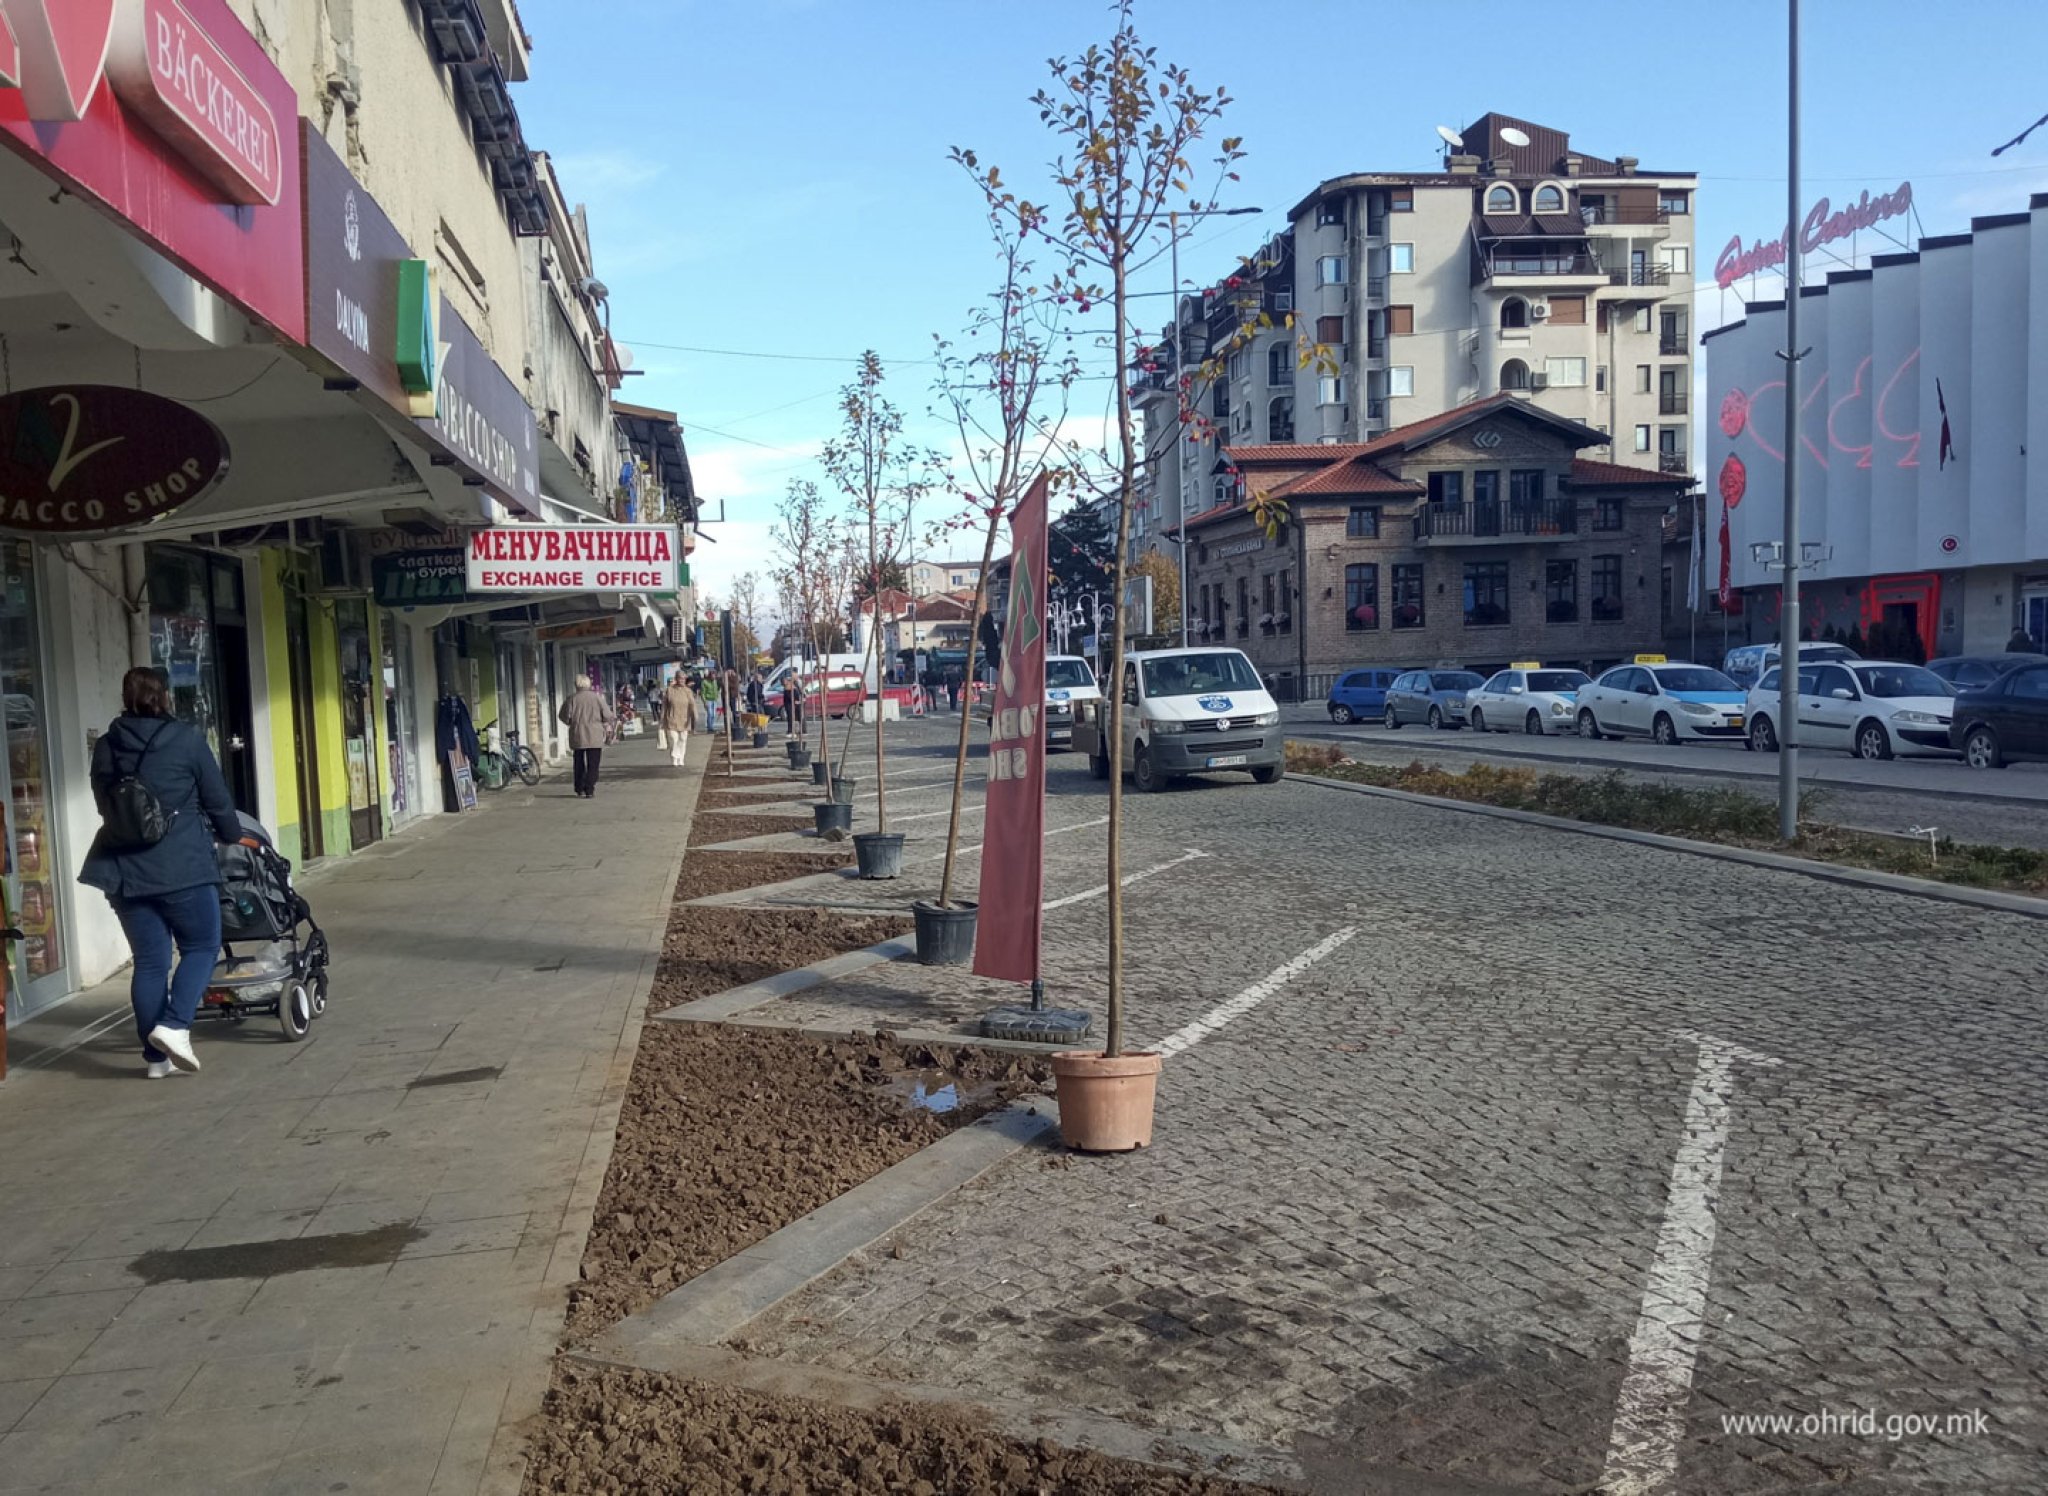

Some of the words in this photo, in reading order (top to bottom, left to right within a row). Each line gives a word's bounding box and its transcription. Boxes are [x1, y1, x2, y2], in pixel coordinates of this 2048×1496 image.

[155, 10, 271, 183] BÄCKEREI
[434, 375, 490, 471] OBACCO
[491, 426, 518, 491] SHOP
[0, 496, 105, 523] ACCO
[124, 457, 202, 513] SHOP
[471, 531, 671, 566] МЕНУВАЧНИЦА
[481, 571, 584, 587] EXCHANGE
[596, 571, 662, 587] OFFICE
